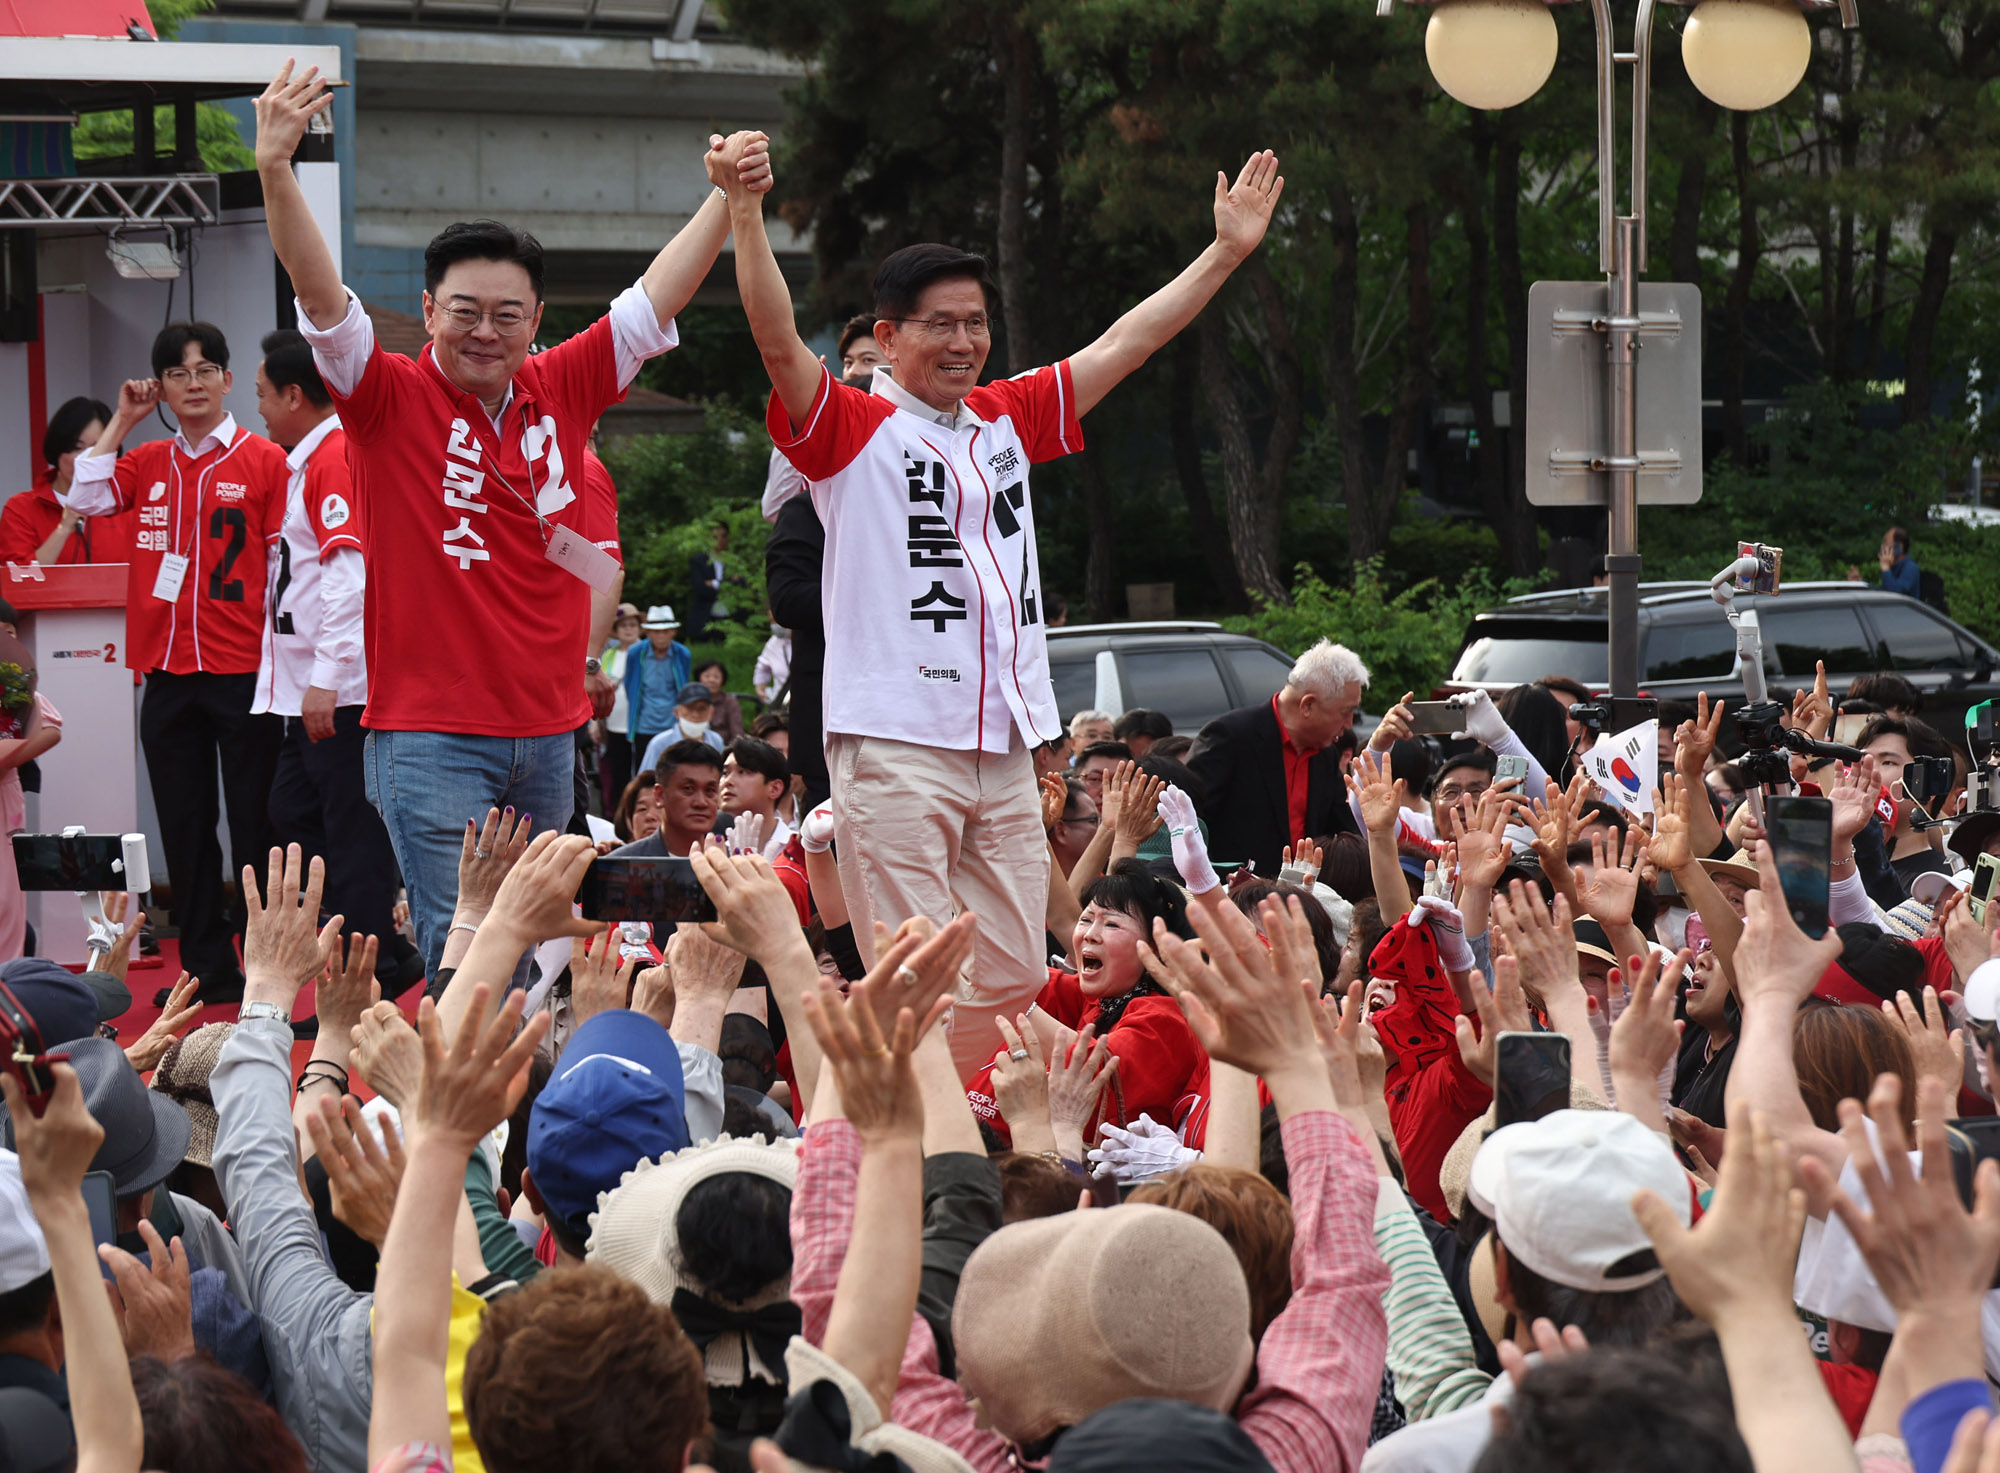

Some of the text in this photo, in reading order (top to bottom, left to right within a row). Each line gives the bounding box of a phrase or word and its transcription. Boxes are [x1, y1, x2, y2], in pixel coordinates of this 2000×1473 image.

[520, 415, 576, 517] 2
[216, 482, 247, 492] PEOPLE
[216, 490, 245, 500] POWER
[139, 505, 168, 527] 국민
[136, 530, 168, 552] 의힘
[209, 507, 247, 602] 2
[104, 643, 117, 663] 2
[923, 669, 957, 679] 국민의힘
[967, 1090, 999, 1111] PEOPLE
[969, 1101, 997, 1120] OWER
